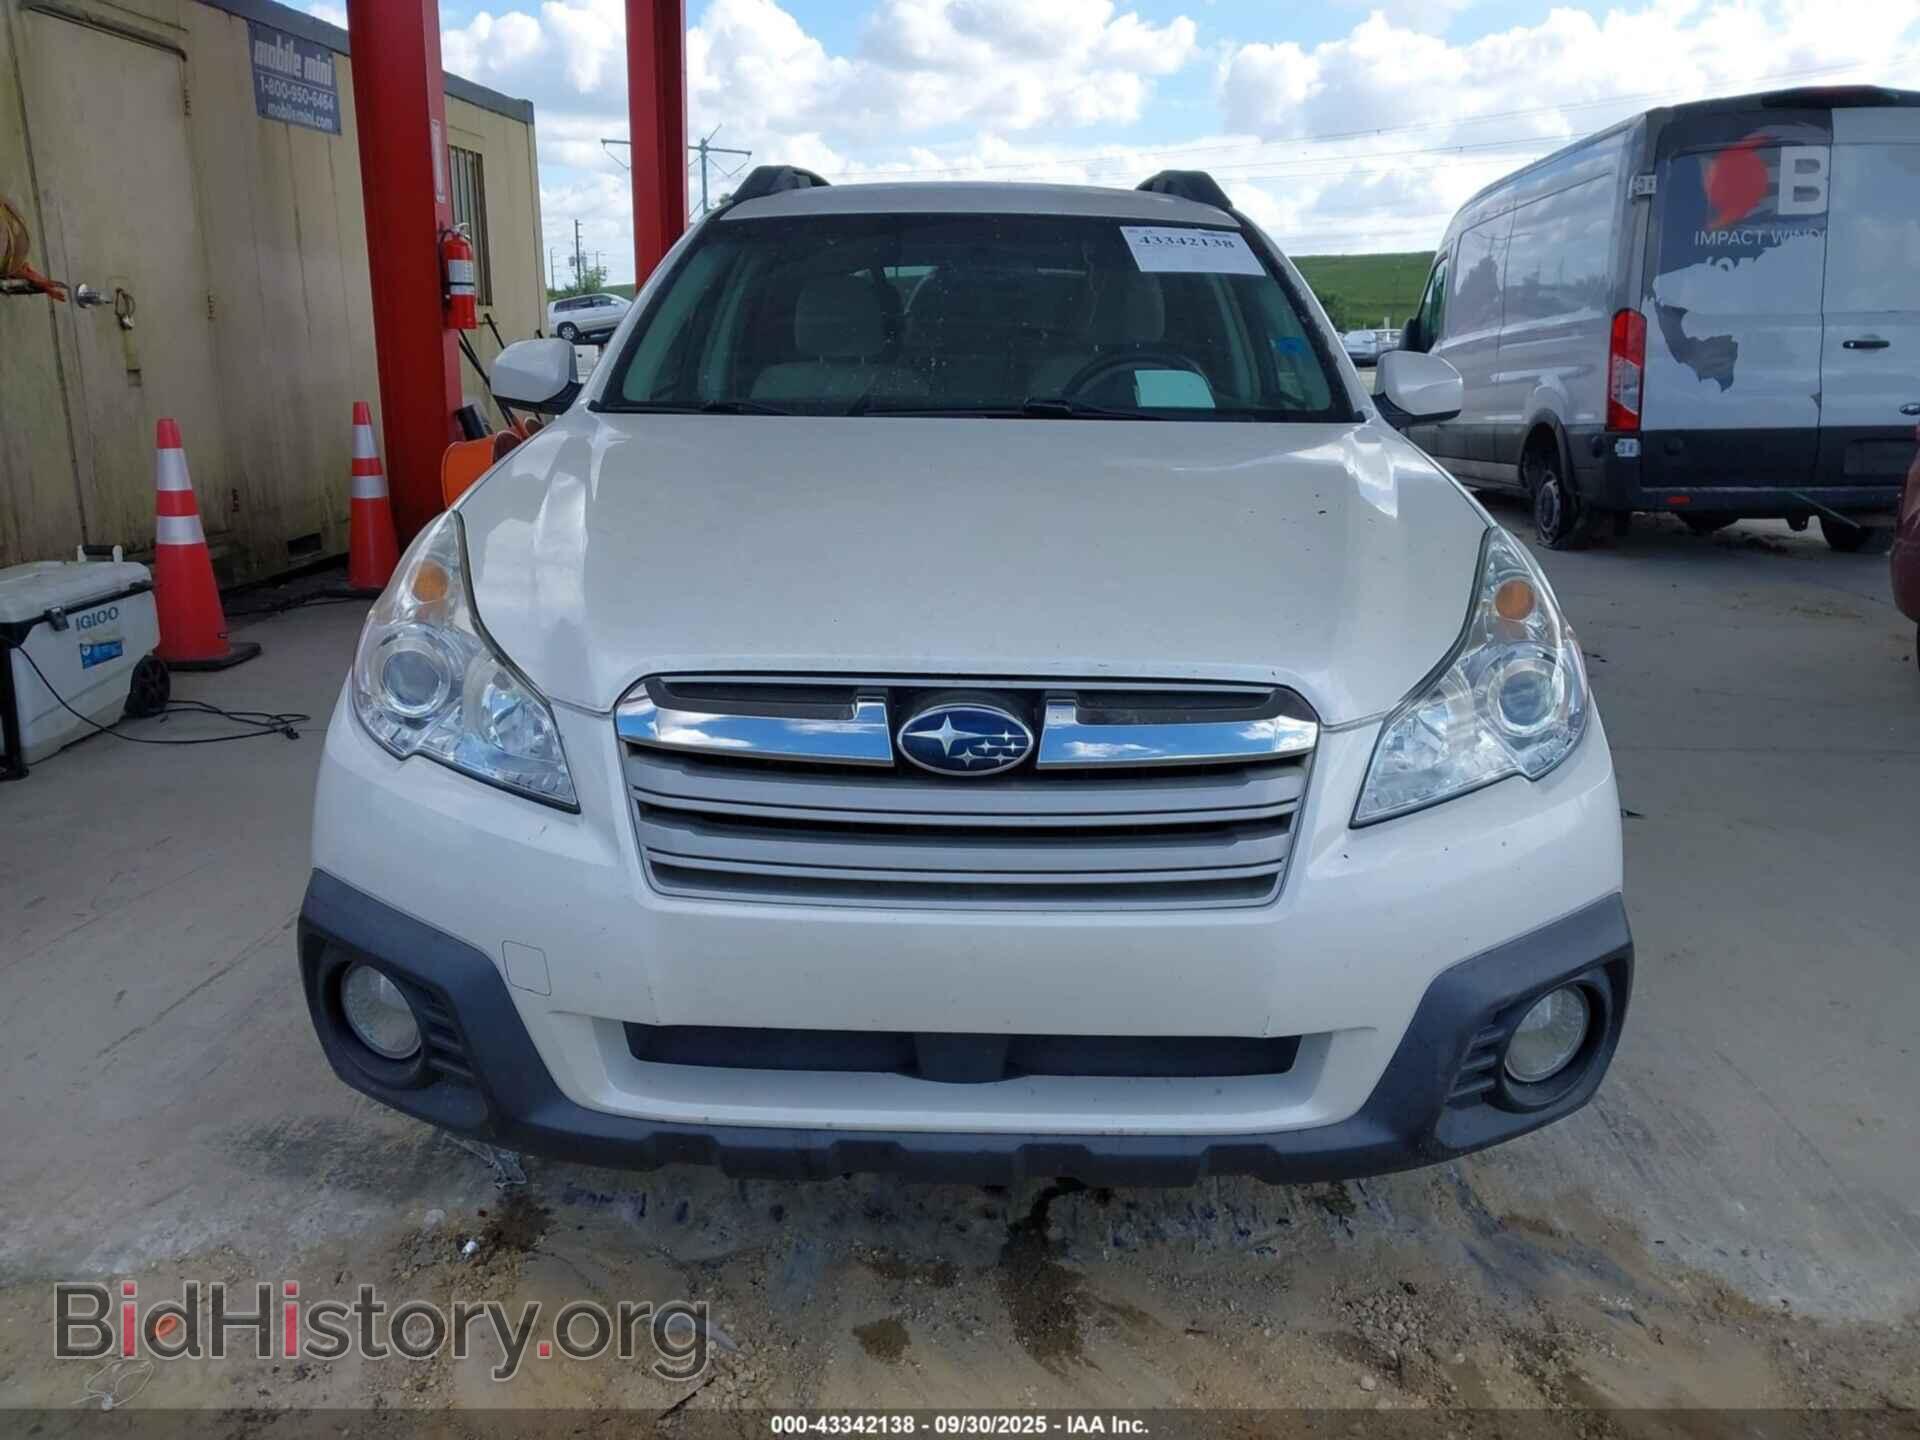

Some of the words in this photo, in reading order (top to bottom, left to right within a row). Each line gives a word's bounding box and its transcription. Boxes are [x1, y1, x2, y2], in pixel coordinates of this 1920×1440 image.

[254, 33, 302, 78] mobile
[303, 53, 332, 86] mini
[1139, 235, 1235, 249] 43342138
[1694, 230, 1764, 246] IMPACT
